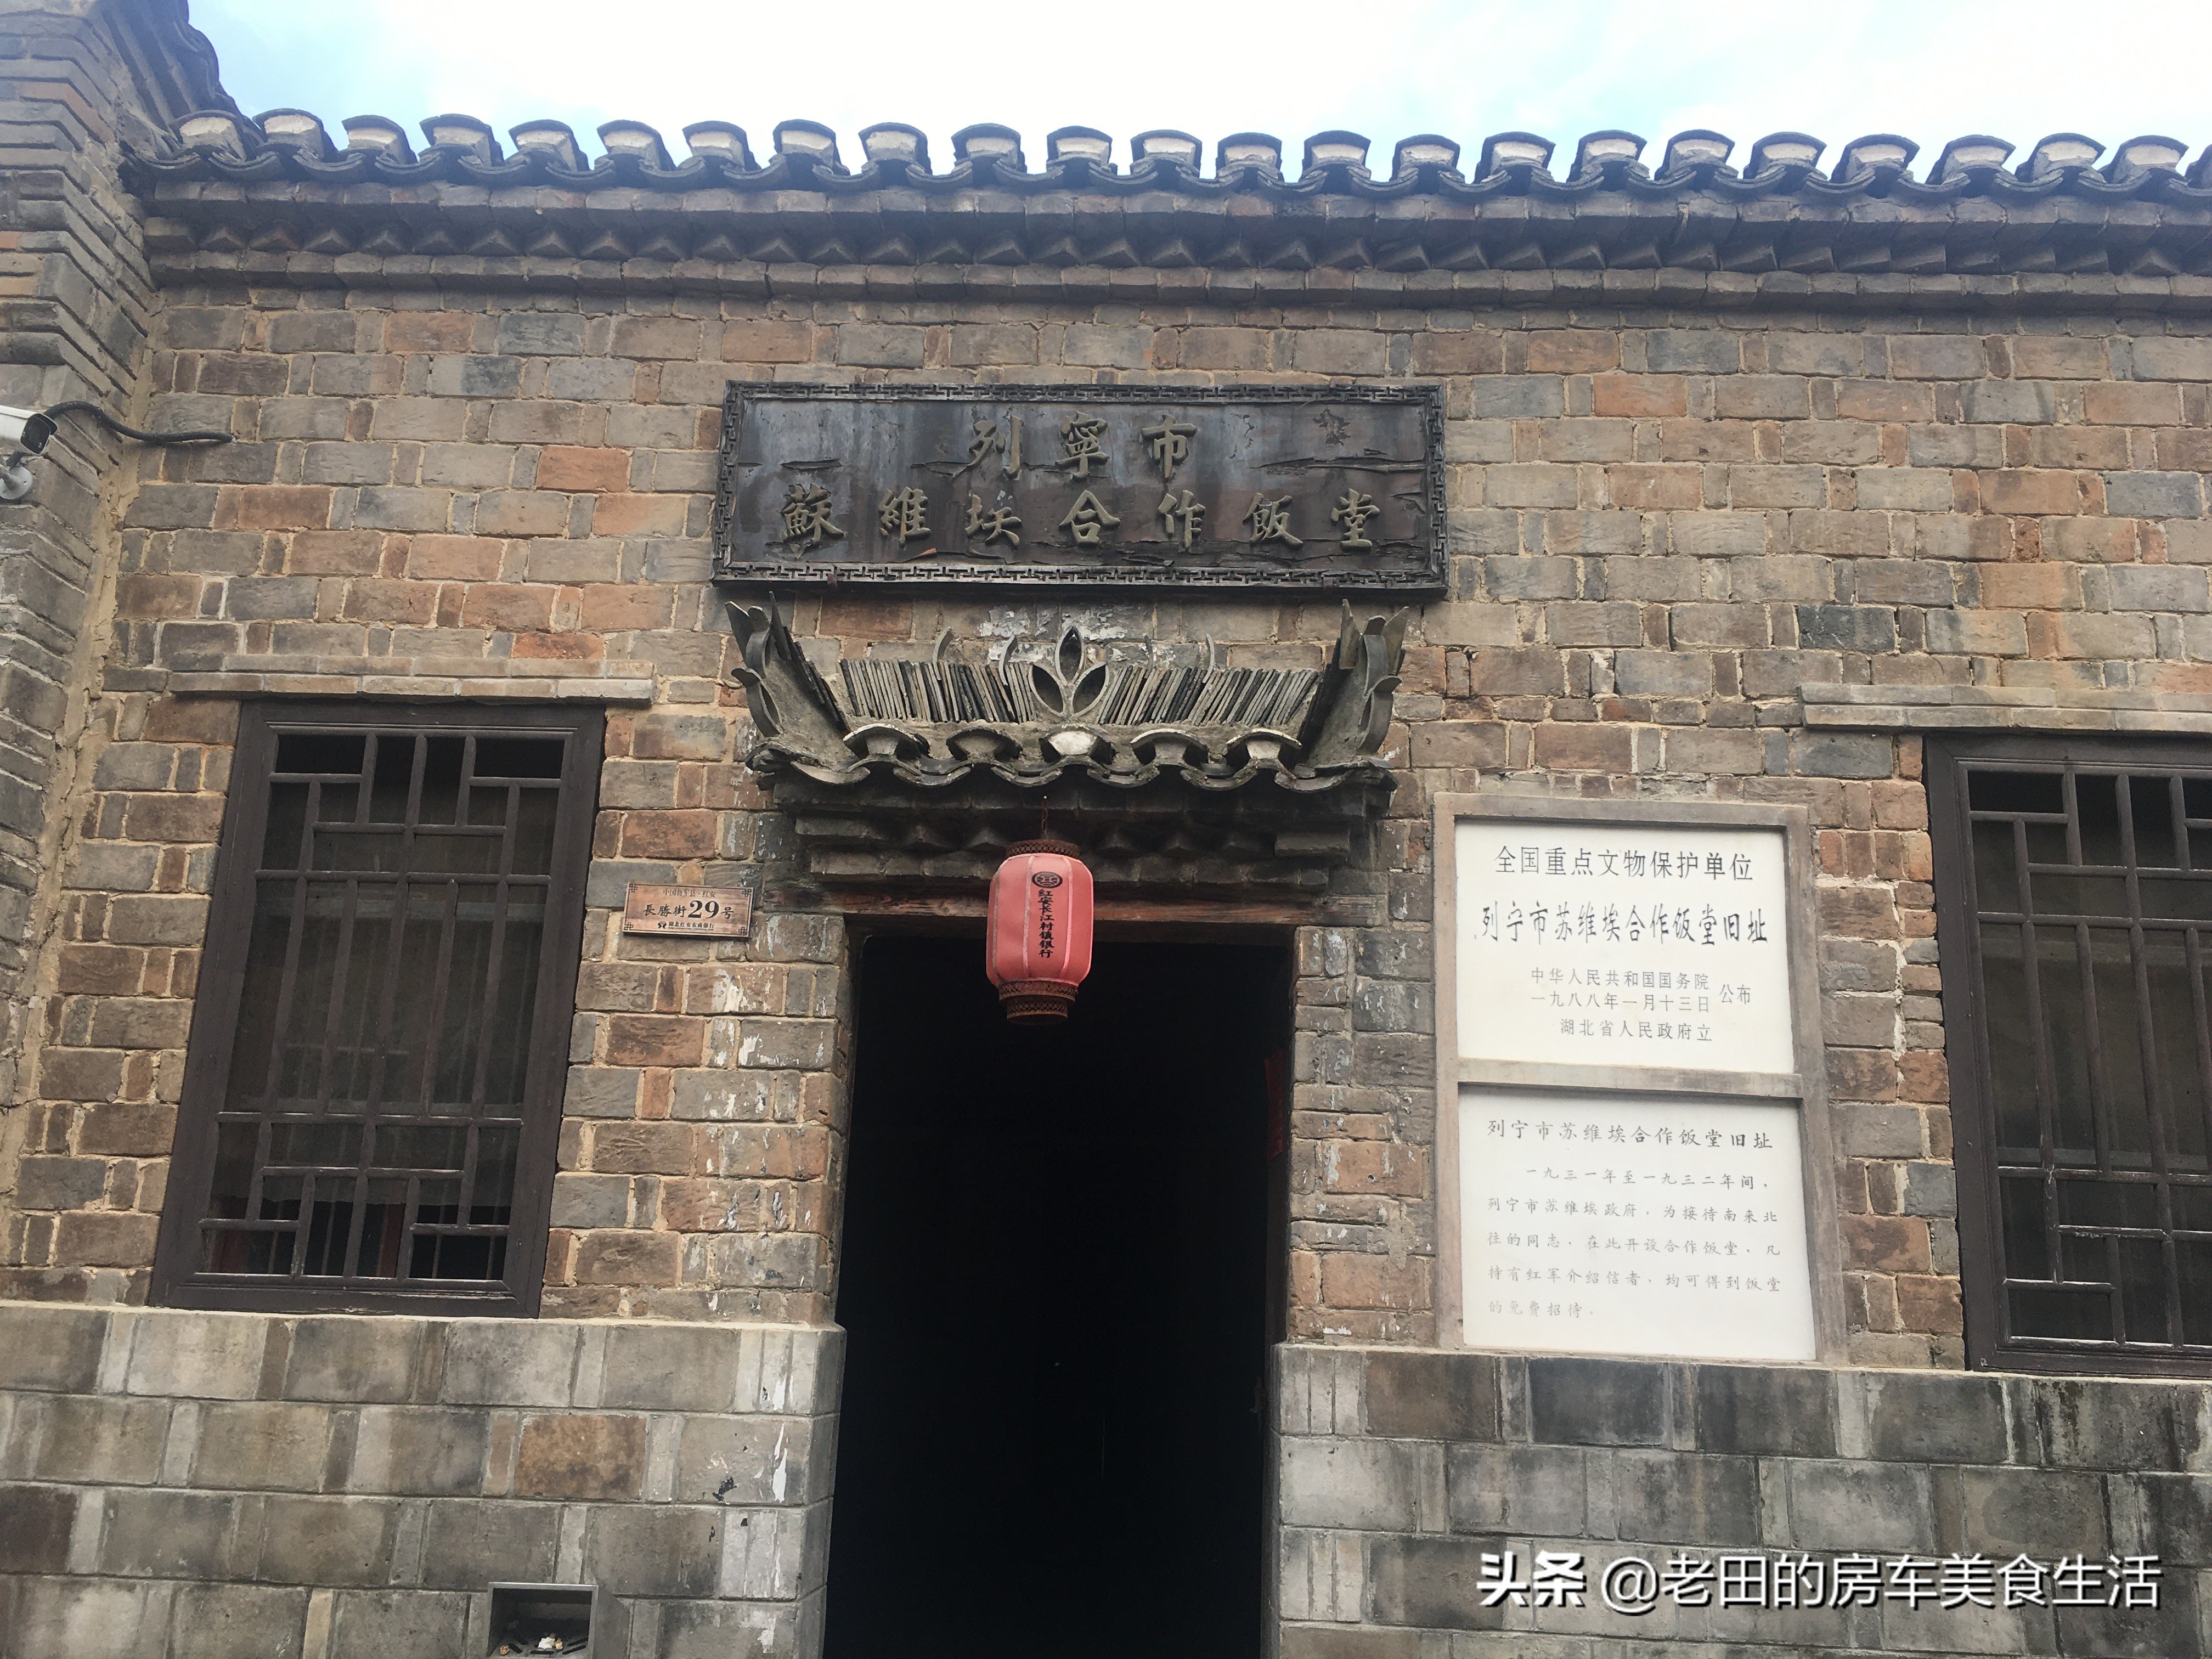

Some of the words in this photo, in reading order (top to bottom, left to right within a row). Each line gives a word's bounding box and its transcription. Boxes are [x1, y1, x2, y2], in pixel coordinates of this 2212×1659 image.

[967, 411, 1198, 481] 列寧市
[1493, 845, 1753, 881] 全国重点文物保护单位
[1038, 888, 1054, 958] 红安长江村镇银行
[1481, 899, 1768, 946] 列宁市苏维埃合作饭堂旧址
[1531, 967, 1709, 991] 中华人民共和国国务院
[1718, 983, 1752, 1005] 公布
[1531, 990, 1709, 1013] 一九八八年一月十三日
[1560, 1018, 1712, 1042] 湖北省人民政府立
[1487, 1119, 1773, 1149] 列宁市苏维埃合作饭堂旧址
